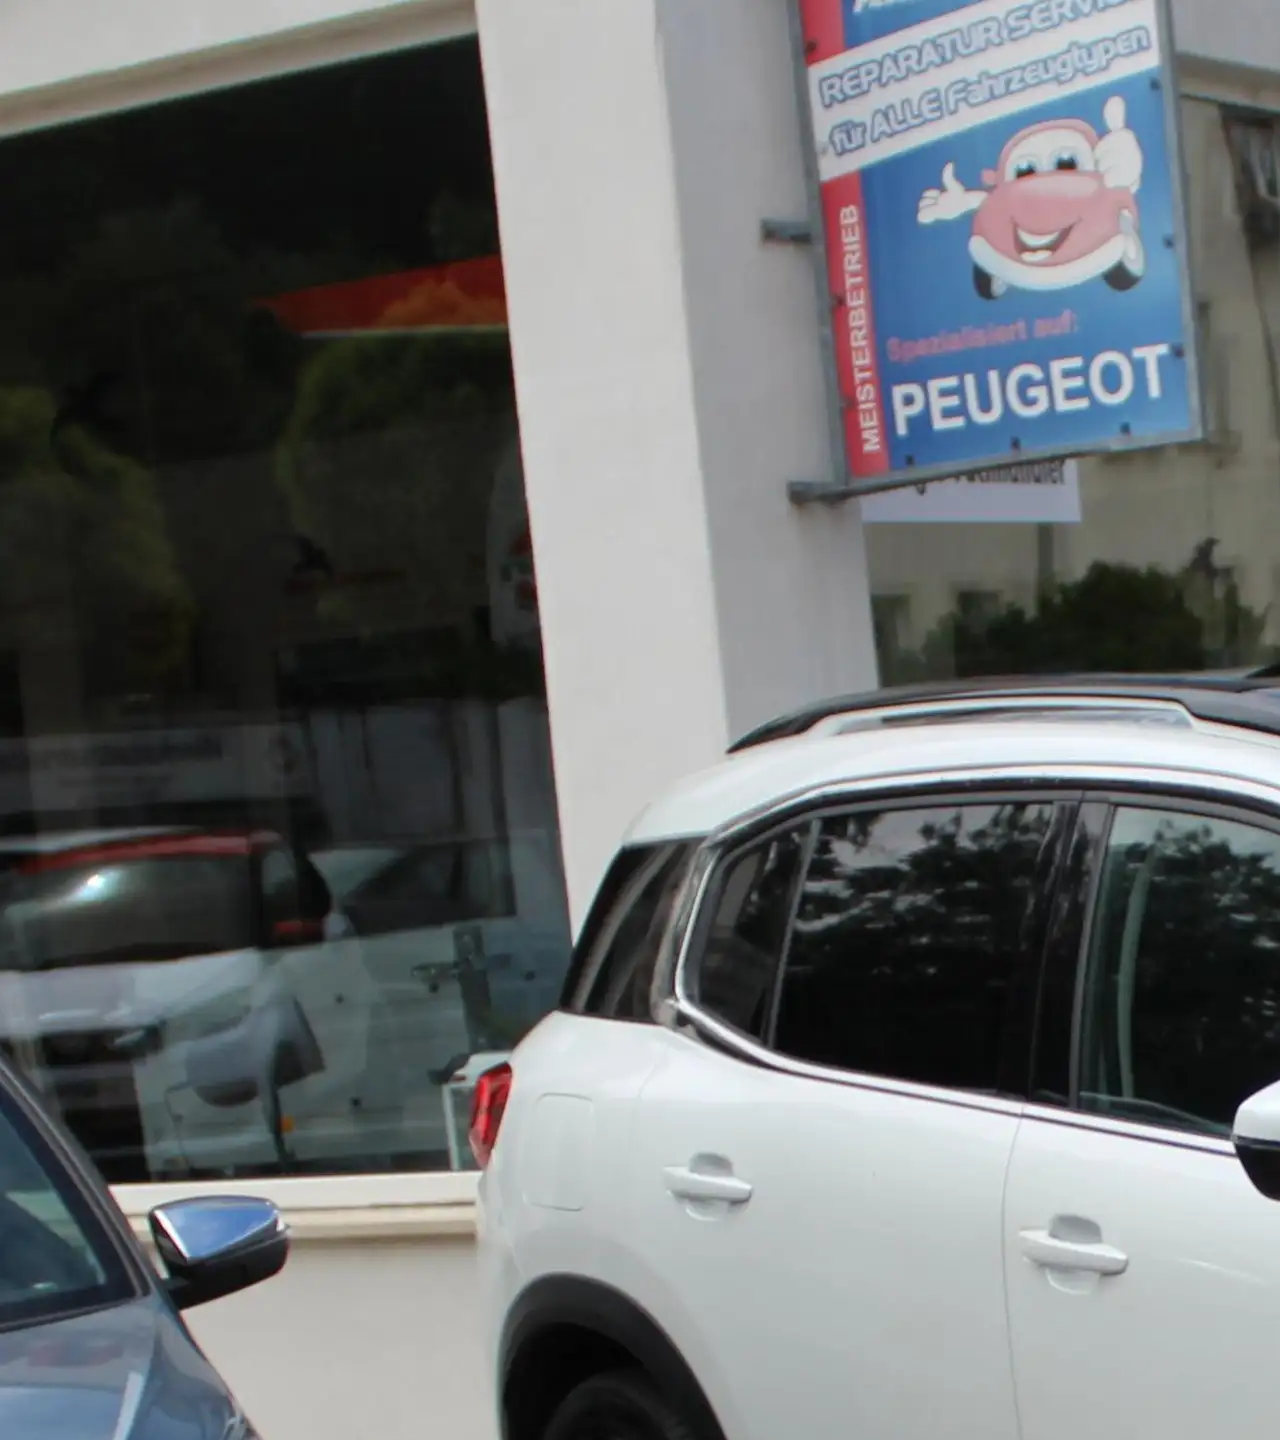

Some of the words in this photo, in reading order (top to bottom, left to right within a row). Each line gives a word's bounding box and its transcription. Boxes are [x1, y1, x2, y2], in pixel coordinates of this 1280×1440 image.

[819, 16, 1002, 108] REPARATUR
[1002, 0, 1128, 43] SERV
[829, 119, 866, 155] für
[871, 90, 942, 142] ALLE
[944, 26, 1152, 115] Fahrzeugtypen
[840, 204, 881, 454] MEISTERBETRIEB
[886, 317, 1028, 361] Spezialisiert
[891, 343, 1170, 437] PEUGEOT
